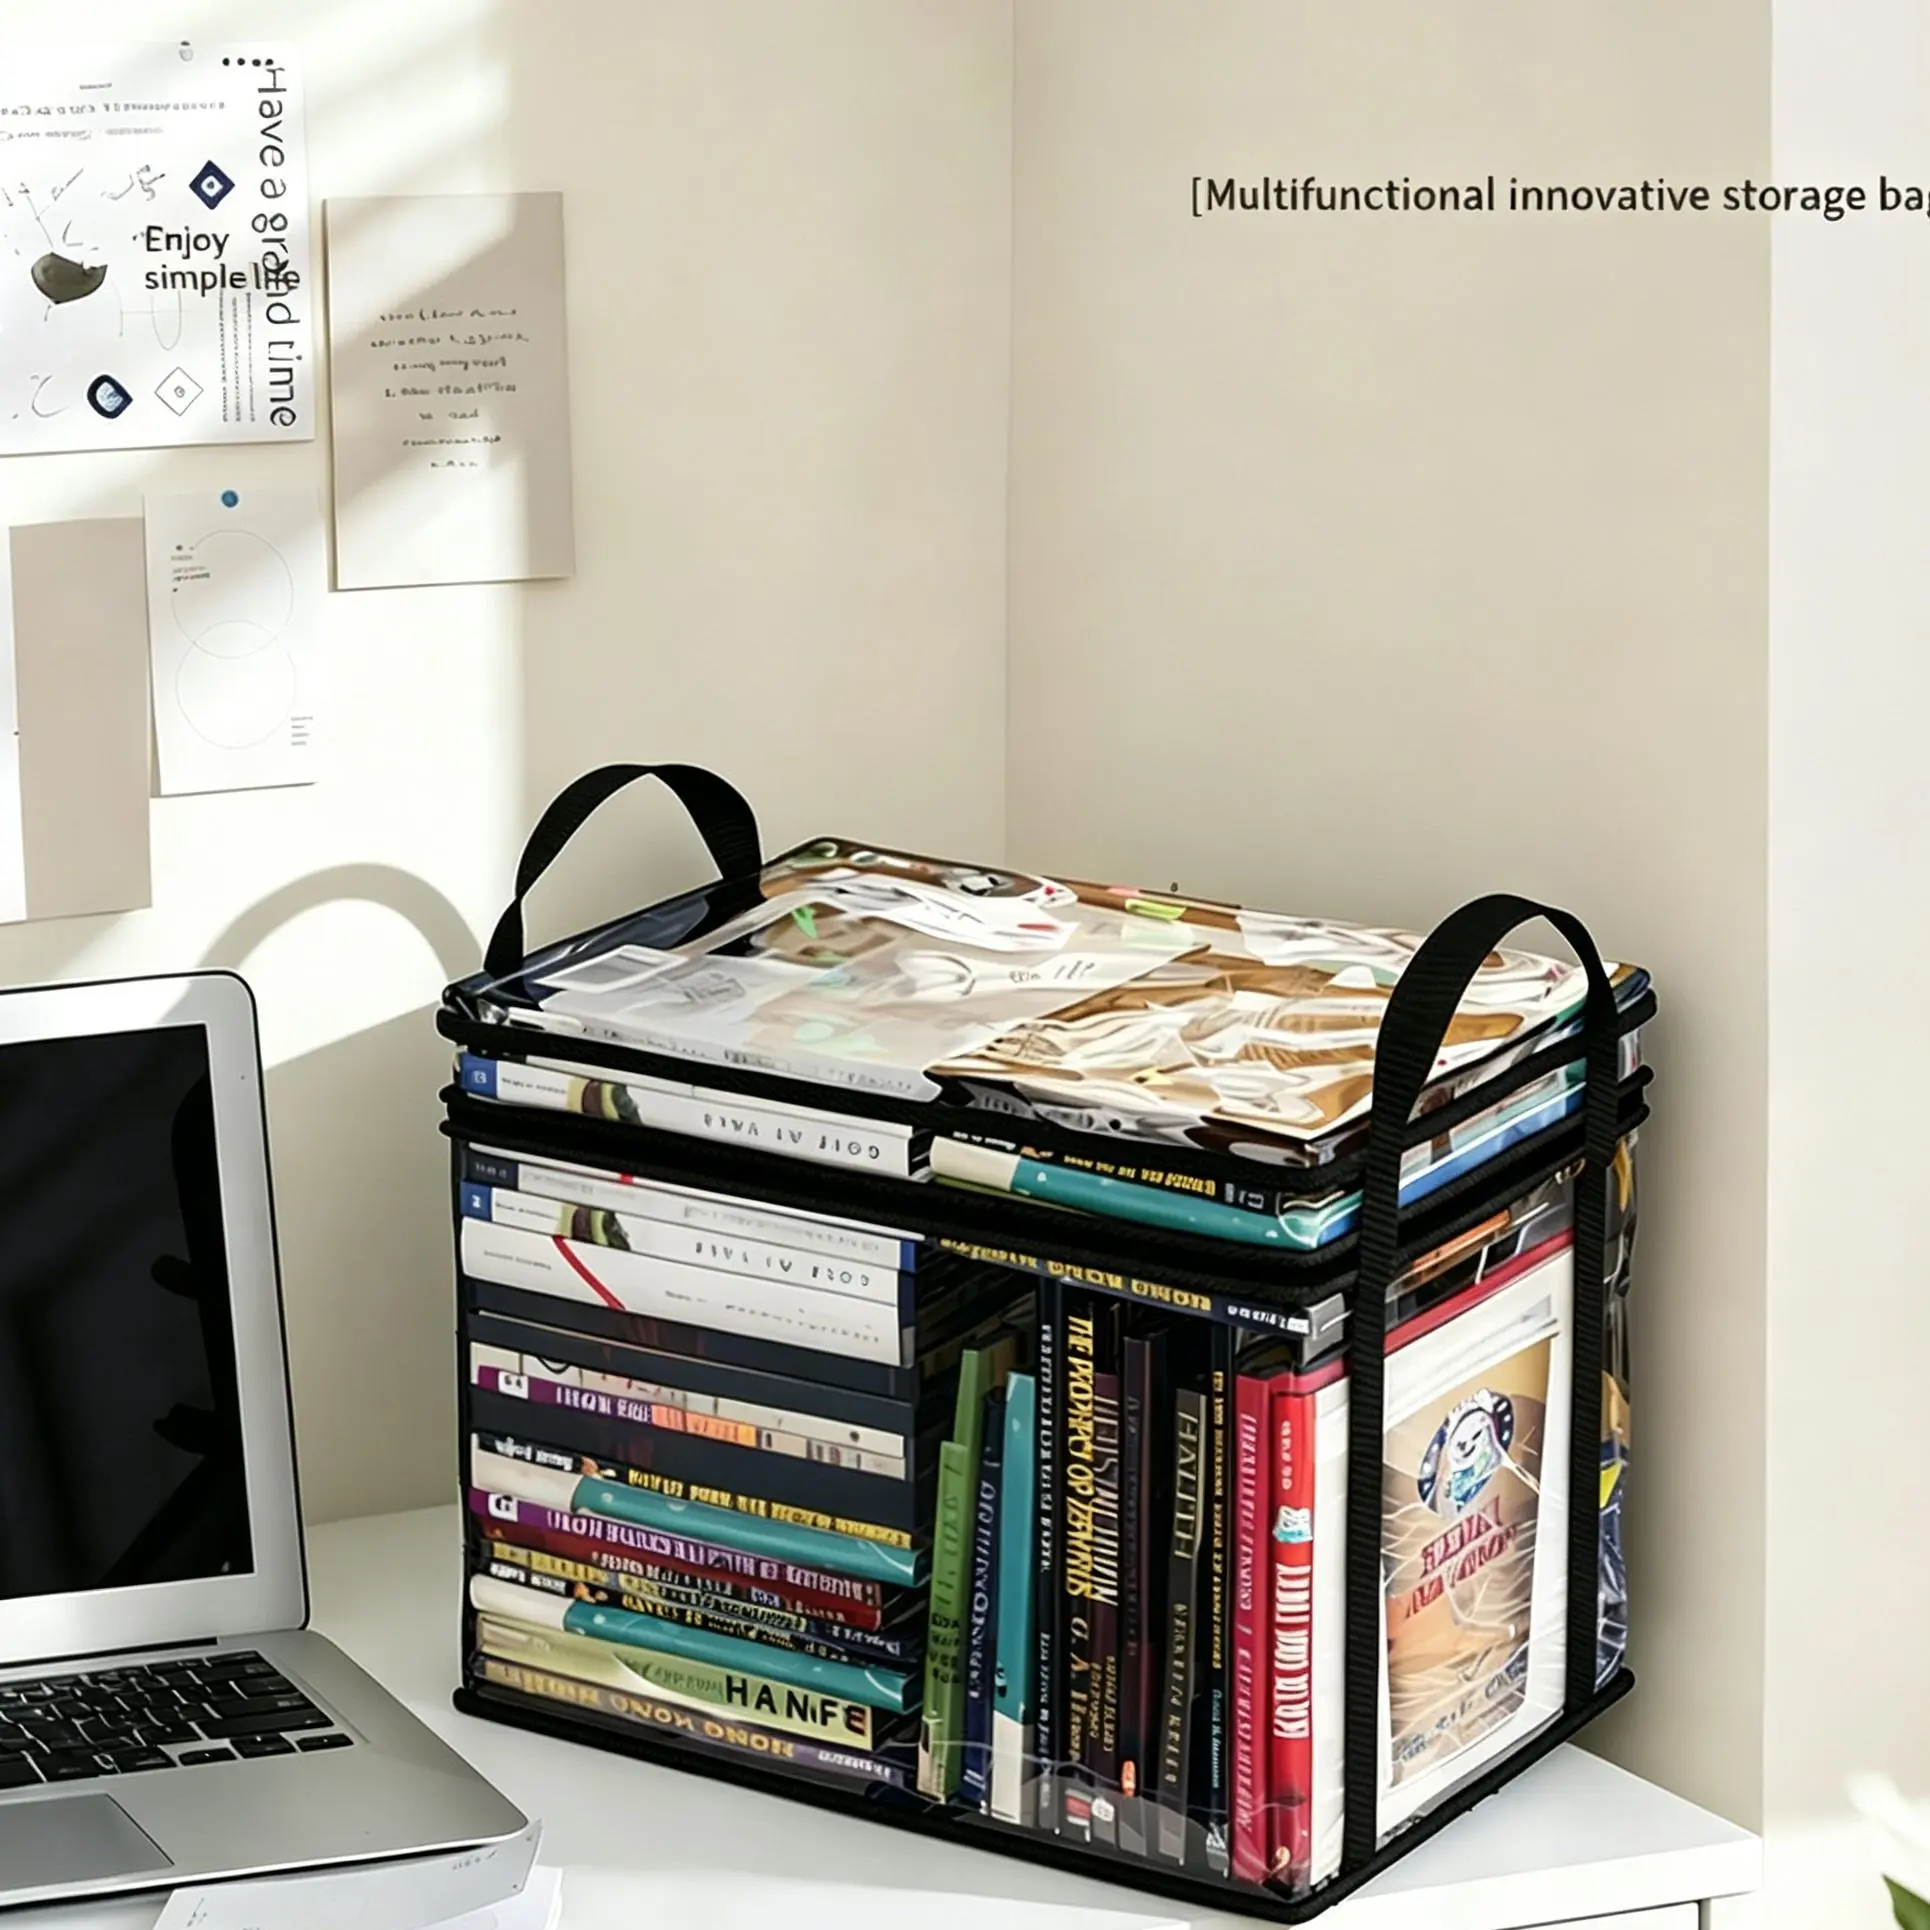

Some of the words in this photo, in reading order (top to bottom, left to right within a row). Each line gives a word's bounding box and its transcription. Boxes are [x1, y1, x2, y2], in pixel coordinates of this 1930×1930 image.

[257, 67, 287, 168] Have
[260, 177, 287, 199] a
[146, 224, 230, 260] Enjoy
[144, 263, 248, 298] simple
